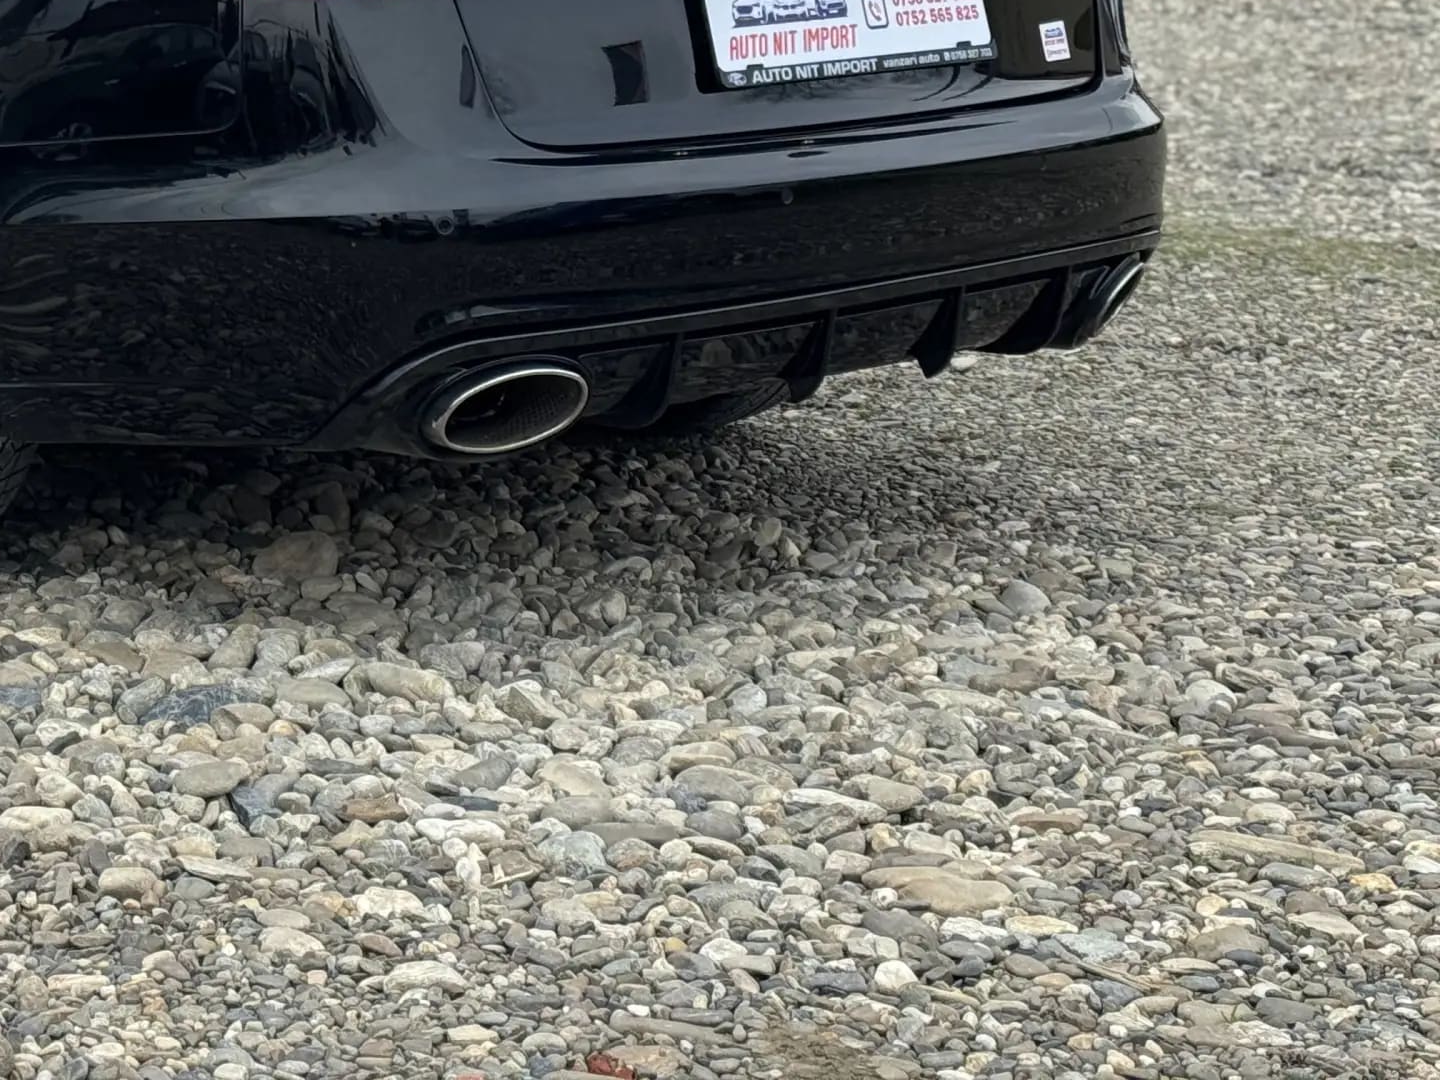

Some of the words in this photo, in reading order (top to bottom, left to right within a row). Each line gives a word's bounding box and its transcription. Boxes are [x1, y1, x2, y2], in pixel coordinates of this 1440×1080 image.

[896, 10, 928, 26] 0752
[930, 7, 953, 23] 565
[956, 5, 979, 21] 825
[730, 34, 768, 61] AUTO
[773, 31, 797, 56] NIT
[803, 24, 858, 53] IMPORT
[752, 69, 793, 83] AUTO
[795, 64, 820, 79] NIT
[823, 58, 878, 76] IMPORT
